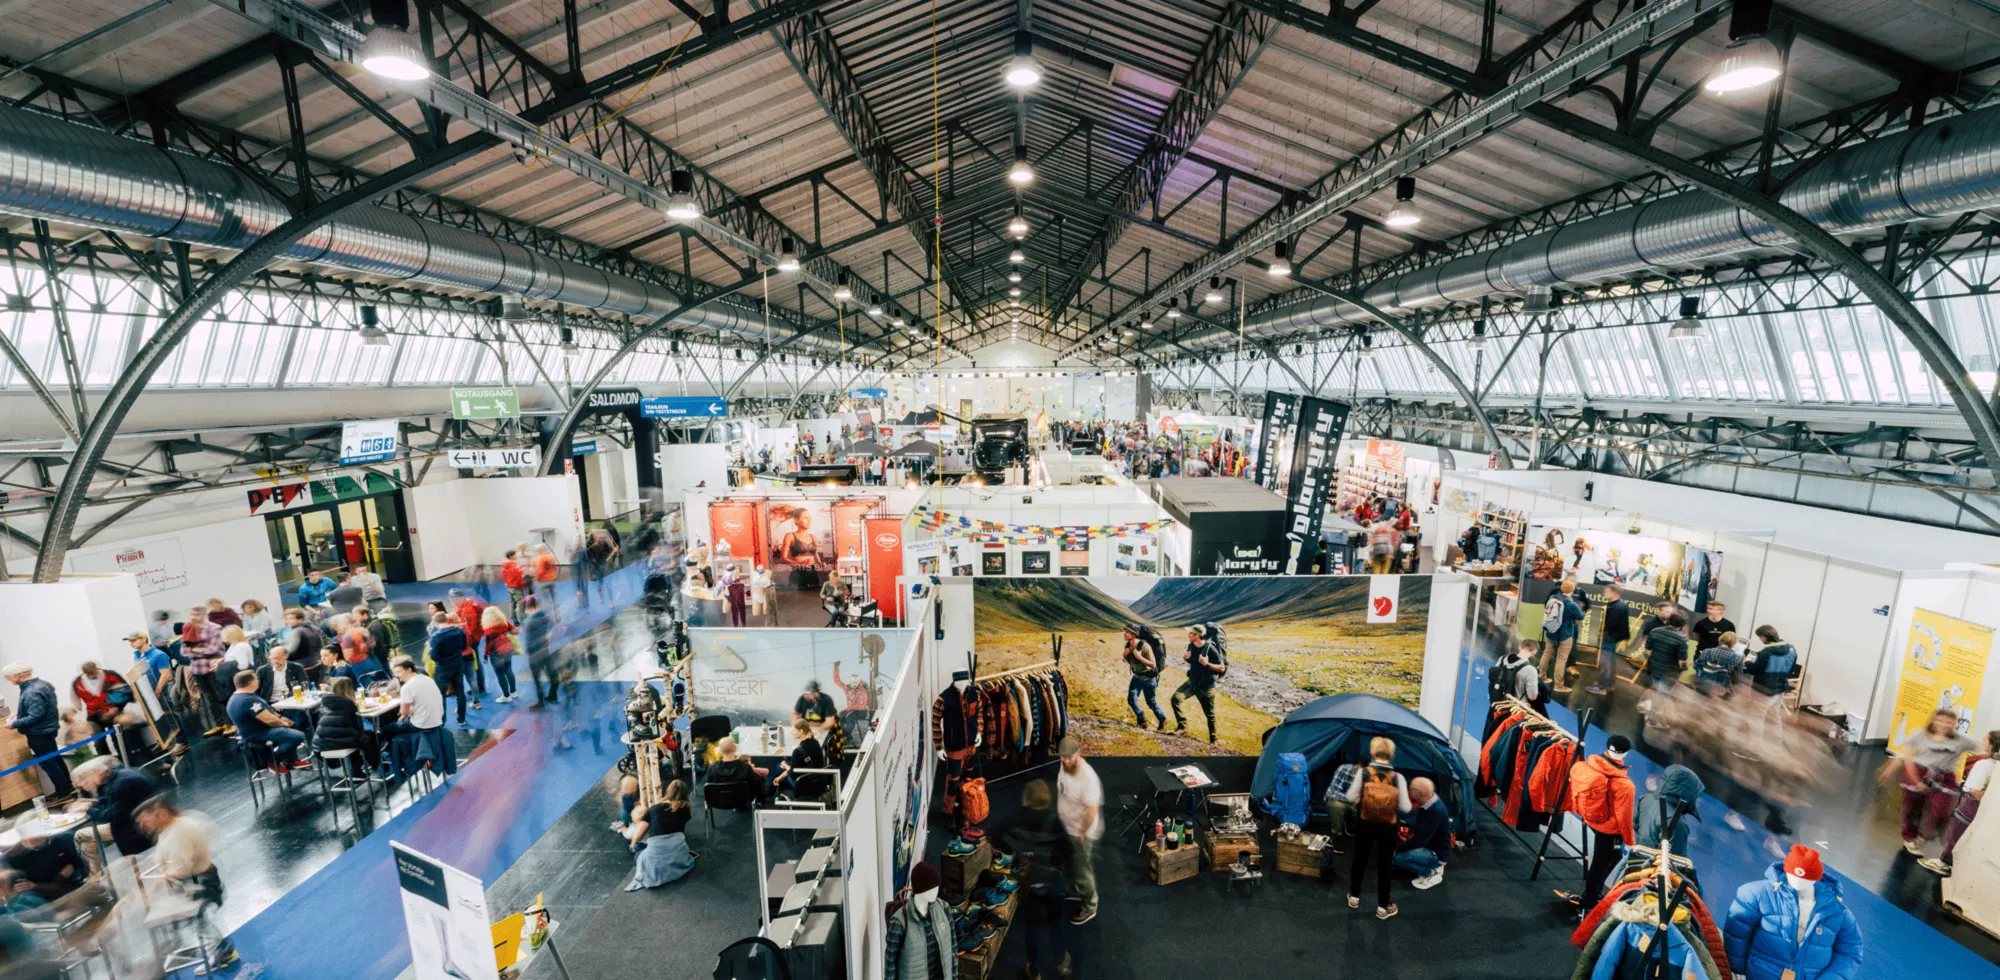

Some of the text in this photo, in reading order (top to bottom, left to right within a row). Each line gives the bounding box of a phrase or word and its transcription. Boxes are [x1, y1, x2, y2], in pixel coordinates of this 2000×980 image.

[455, 389, 513, 399] NOTAUSGANG
[589, 392, 639, 407] SALOMON
[502, 451, 532, 465] WC
[1293, 412, 1334, 534] gloryfy
[1311, 416, 1342, 537] unbreakable
[700, 679, 769, 696] SIEBERT
